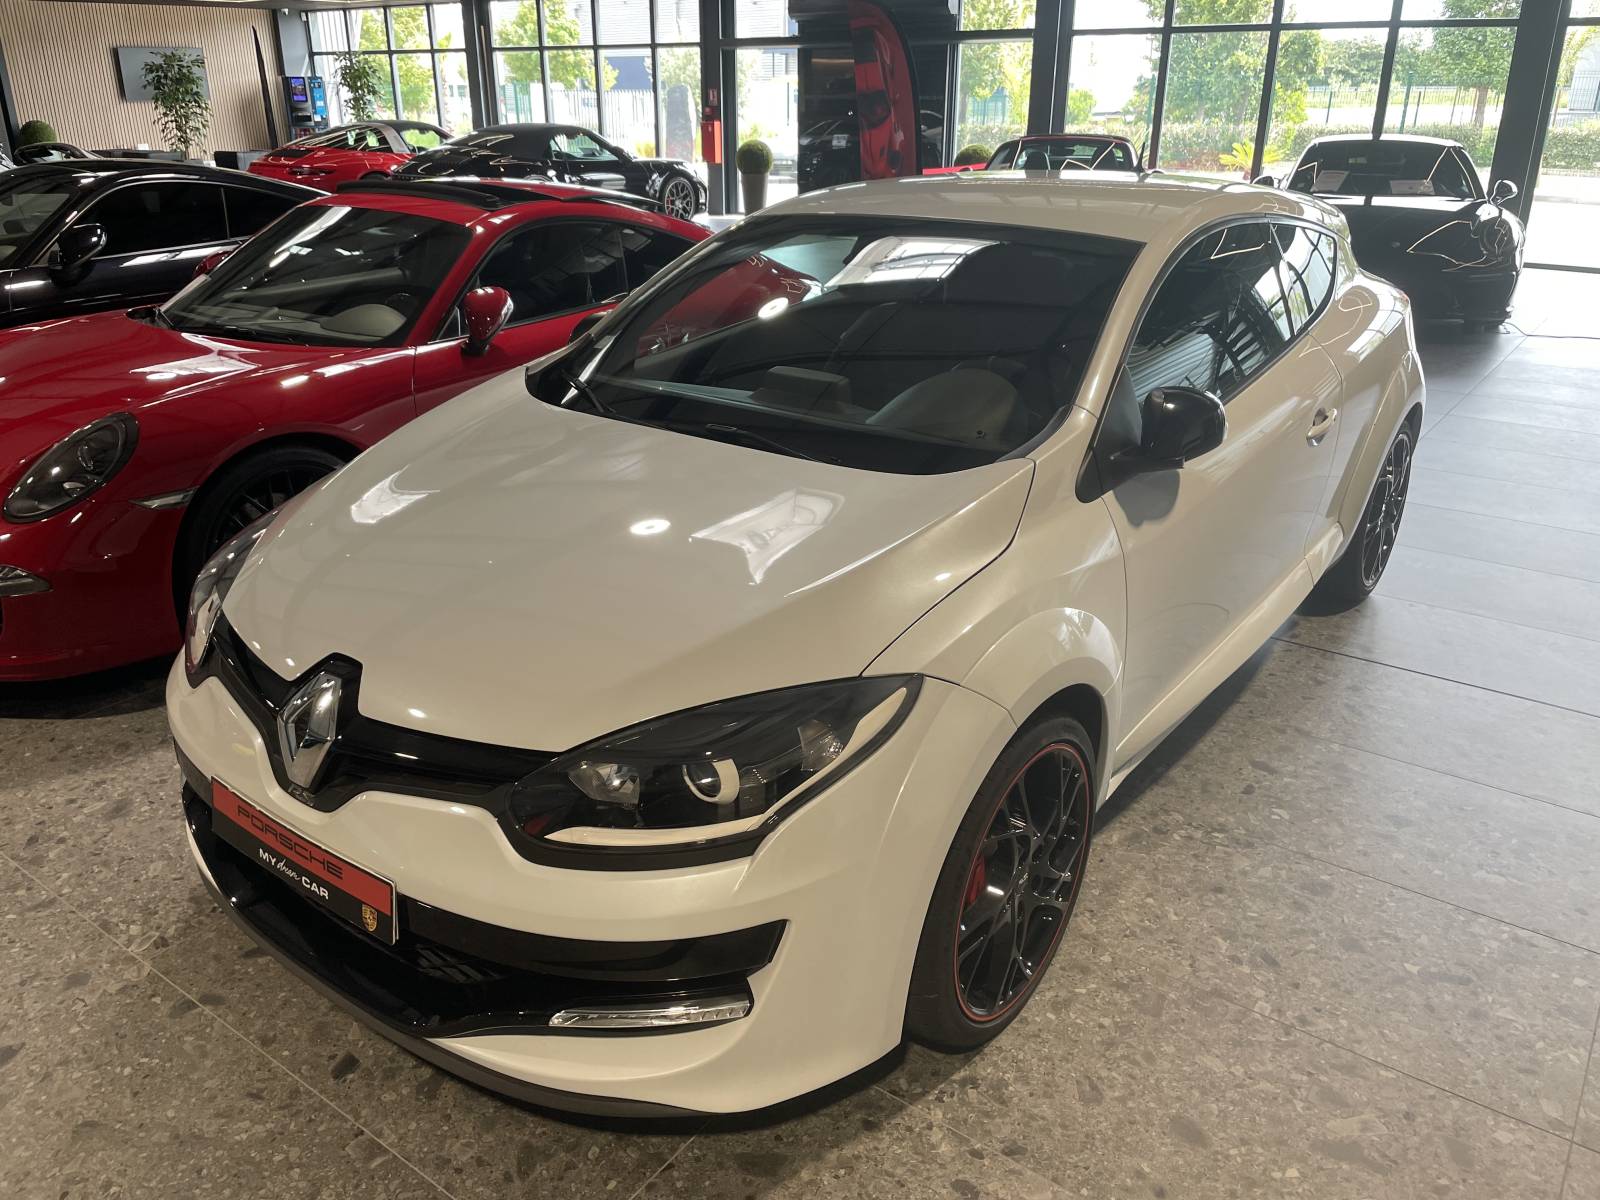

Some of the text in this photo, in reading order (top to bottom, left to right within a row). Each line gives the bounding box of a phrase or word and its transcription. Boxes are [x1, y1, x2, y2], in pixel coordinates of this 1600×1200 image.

[237, 804, 343, 880] PORSCHE
[259, 848, 329, 900] MY dream CAR
